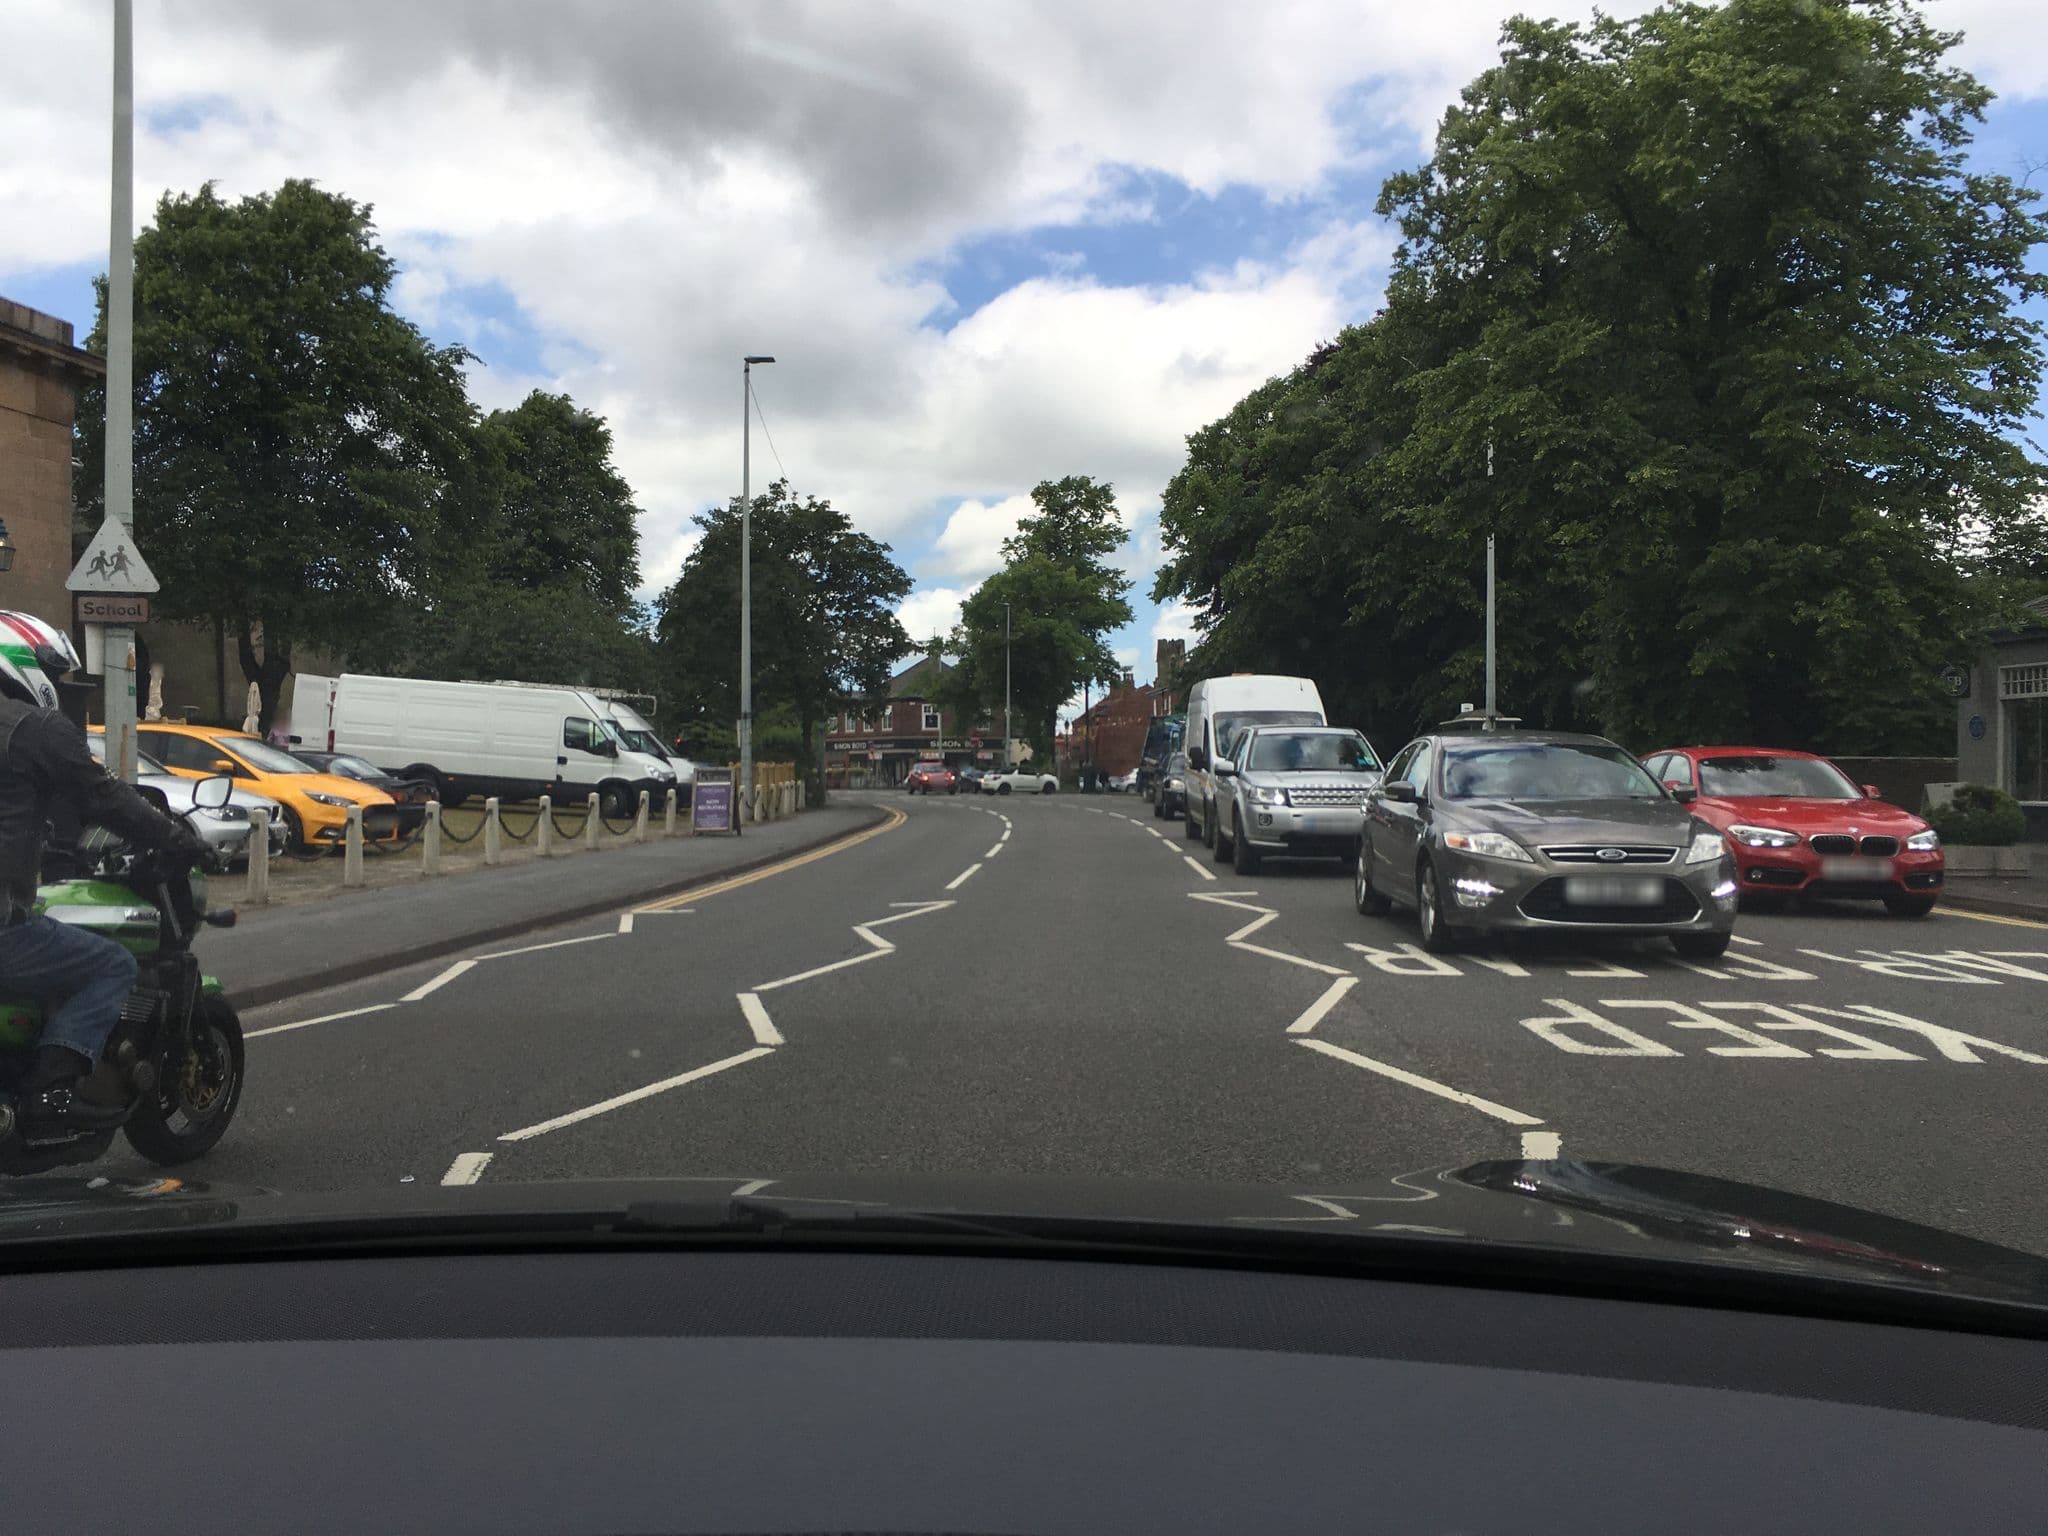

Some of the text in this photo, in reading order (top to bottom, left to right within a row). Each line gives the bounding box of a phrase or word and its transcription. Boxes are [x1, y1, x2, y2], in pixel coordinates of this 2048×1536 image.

[83, 601, 143, 616] School
[964, 740, 984, 748] BD
[1519, 999, 2048, 1065] KEEP
